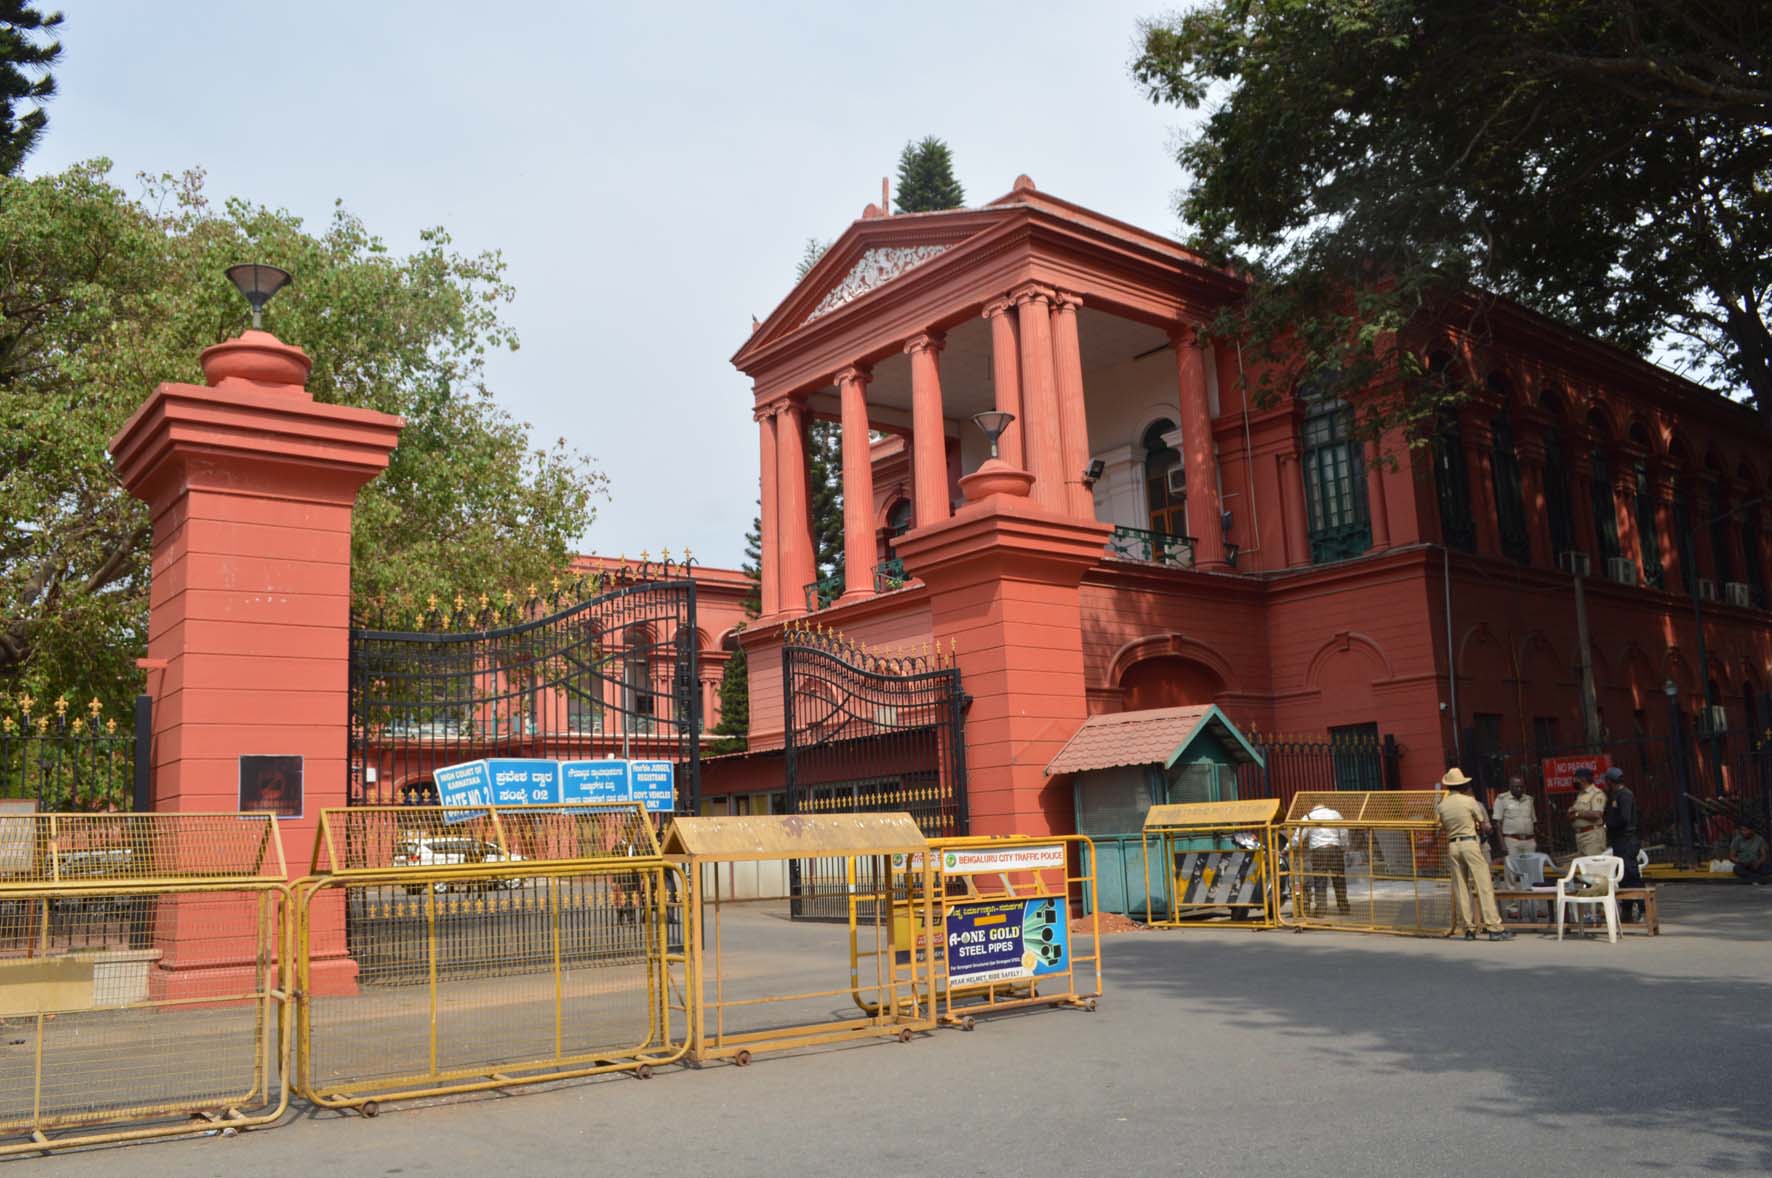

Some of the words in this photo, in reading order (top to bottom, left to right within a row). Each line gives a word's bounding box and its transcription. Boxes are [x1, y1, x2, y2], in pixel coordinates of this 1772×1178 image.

[532, 789, 549, 801] 02
[959, 854, 998, 865] BENGALURU
[999, 853, 1014, 862] CITY
[1015, 852, 1040, 862] TRAFFIC
[1040, 850, 1063, 861] POLICE
[989, 924, 1020, 941] GOLD
[959, 945, 988, 957] STEEL
[988, 941, 1014, 953] PIPES
